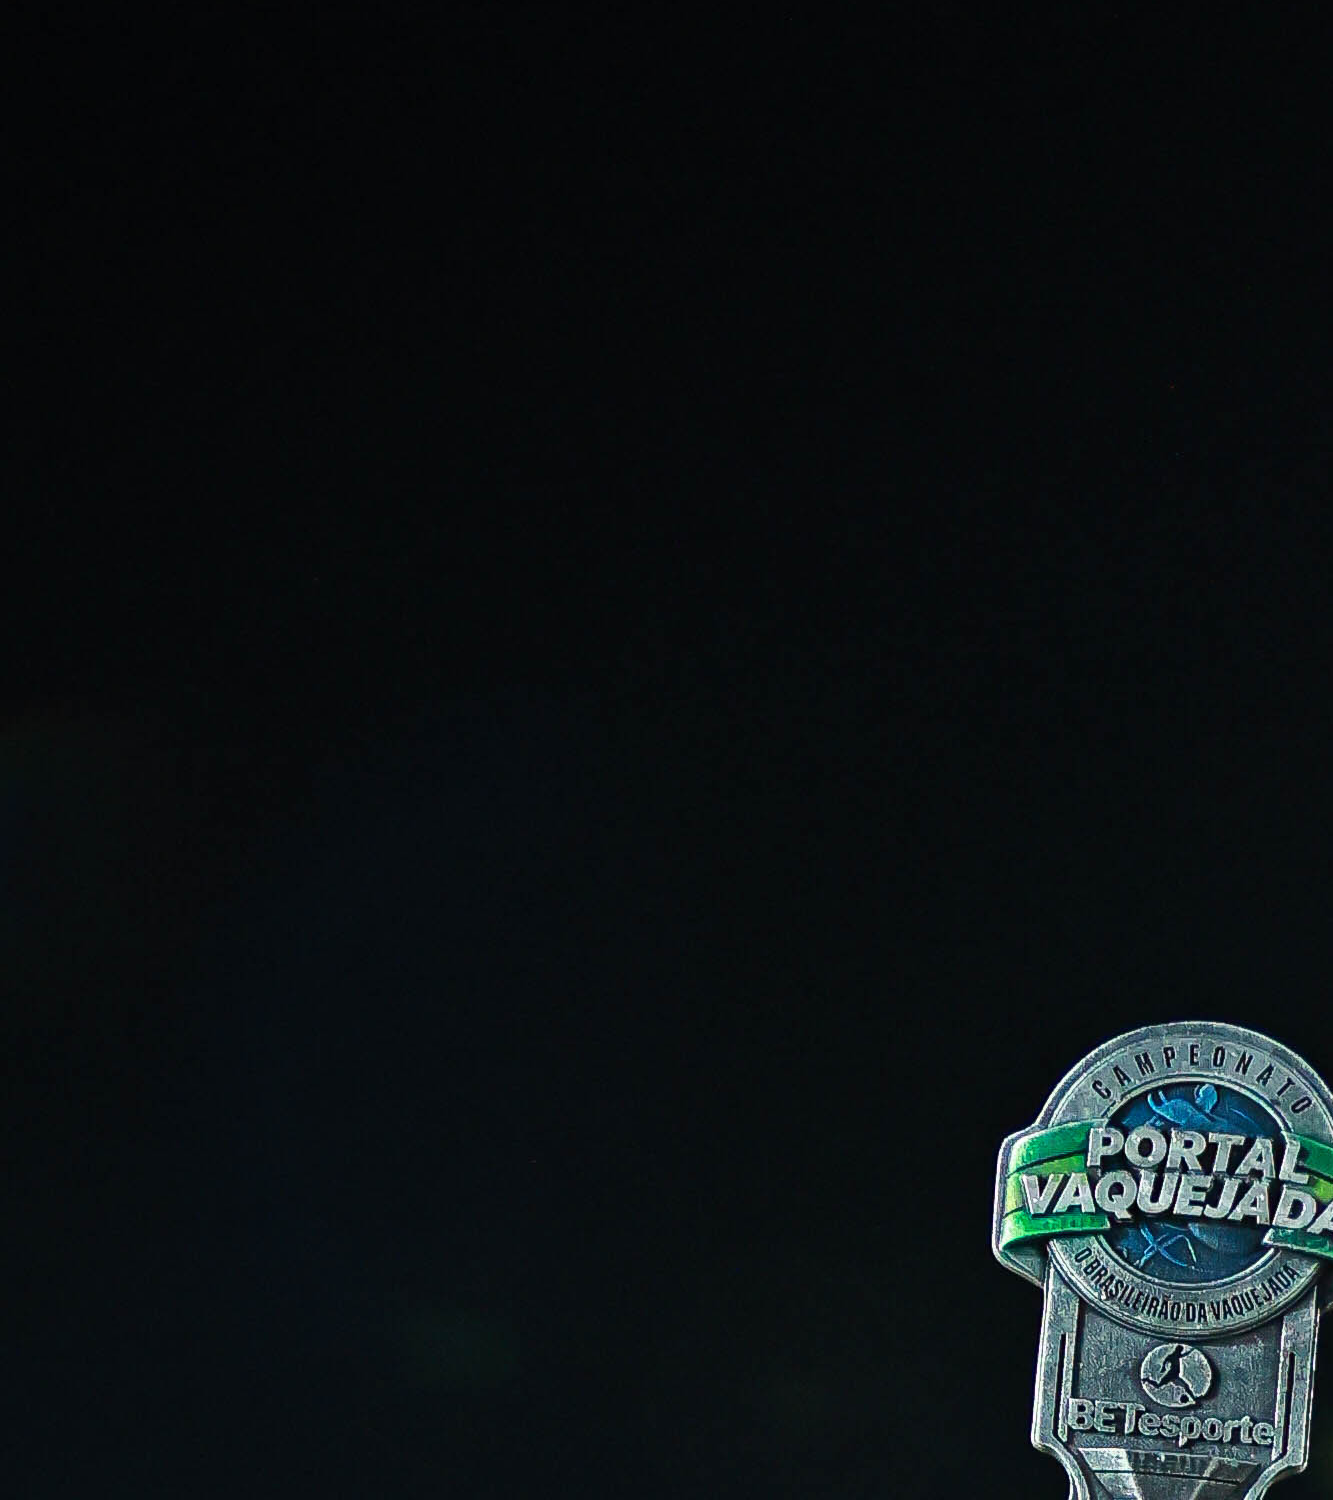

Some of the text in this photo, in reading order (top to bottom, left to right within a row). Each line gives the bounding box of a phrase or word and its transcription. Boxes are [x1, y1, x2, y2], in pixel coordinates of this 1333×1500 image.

[1091, 1043, 1312, 1114] CAMPEONATO
[1086, 1125, 1310, 1184] PORTAL
[1074, 1248, 1301, 1323] O BRASILEIRÃO DA VAQUEJADA
[1067, 1397, 1277, 1447] BETesporte
